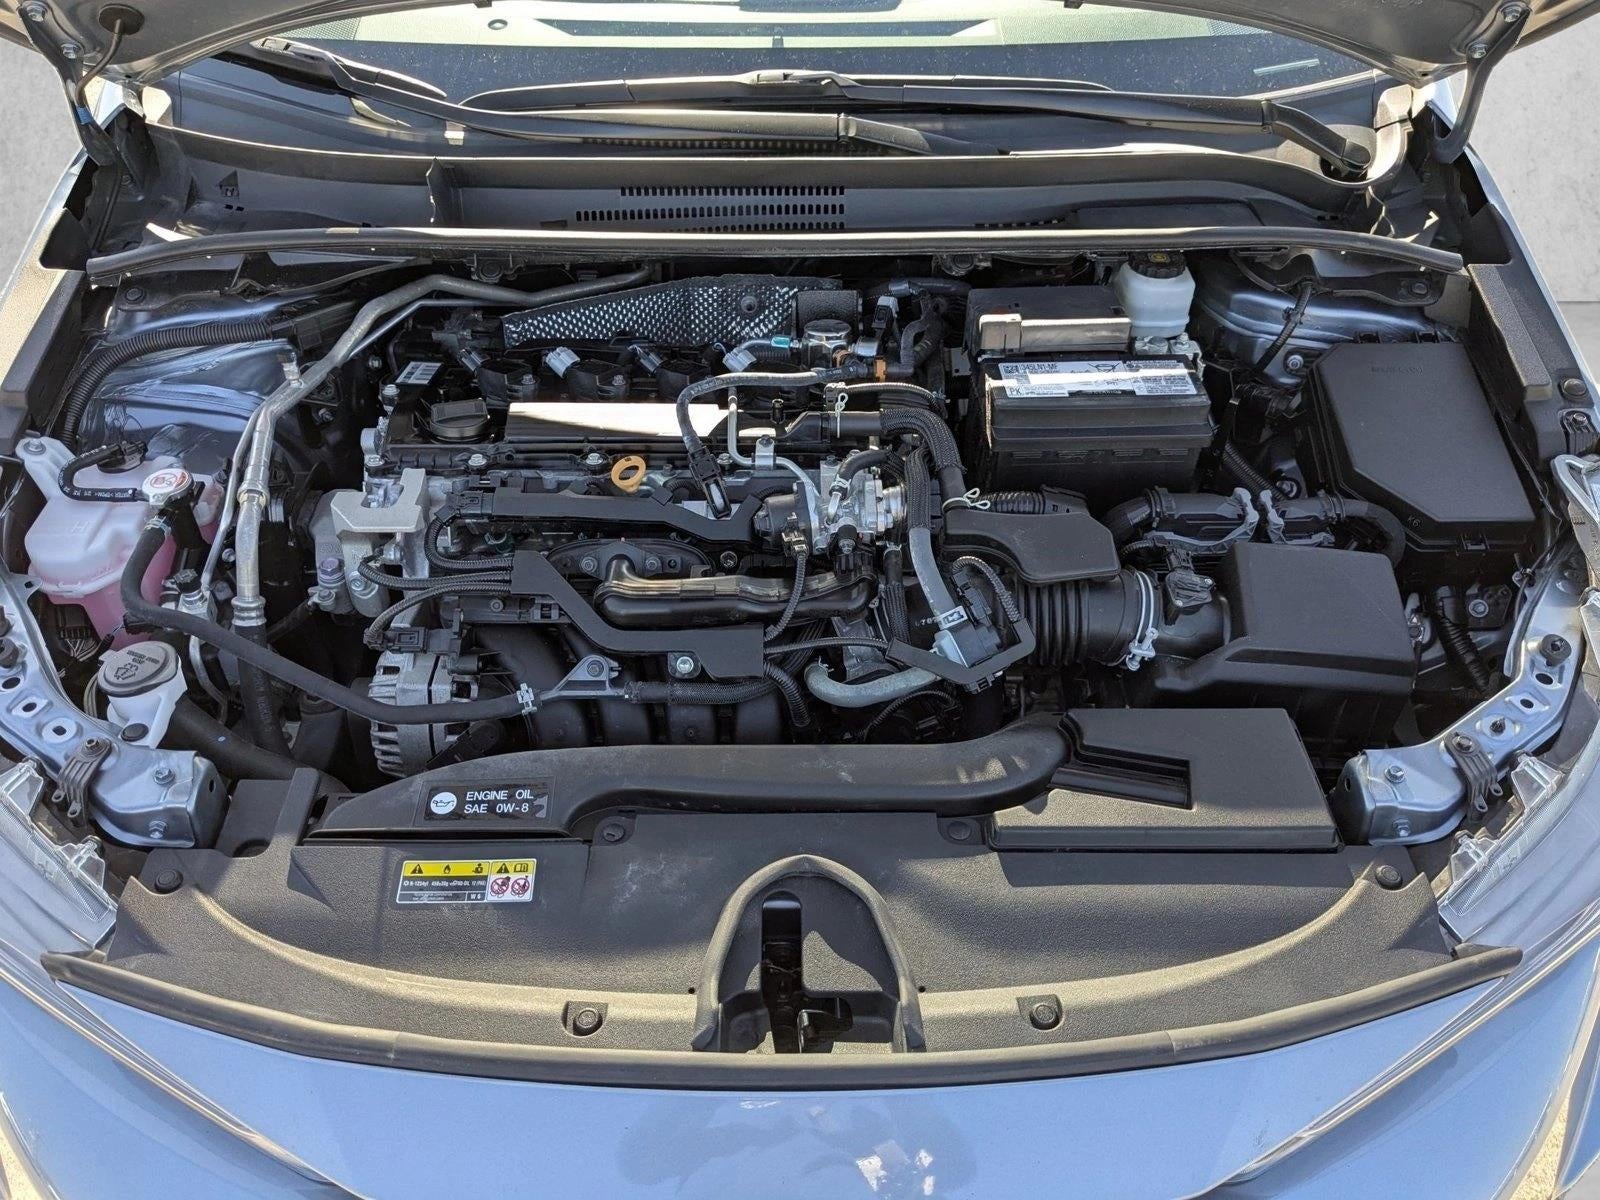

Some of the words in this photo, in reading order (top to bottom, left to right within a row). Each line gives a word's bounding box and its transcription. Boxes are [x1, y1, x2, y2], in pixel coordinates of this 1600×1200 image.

[466, 790, 508, 801] ENGINE
[515, 789, 534, 800] OIL
[464, 803, 488, 813] SAE
[496, 802, 529, 813] 0W-8
